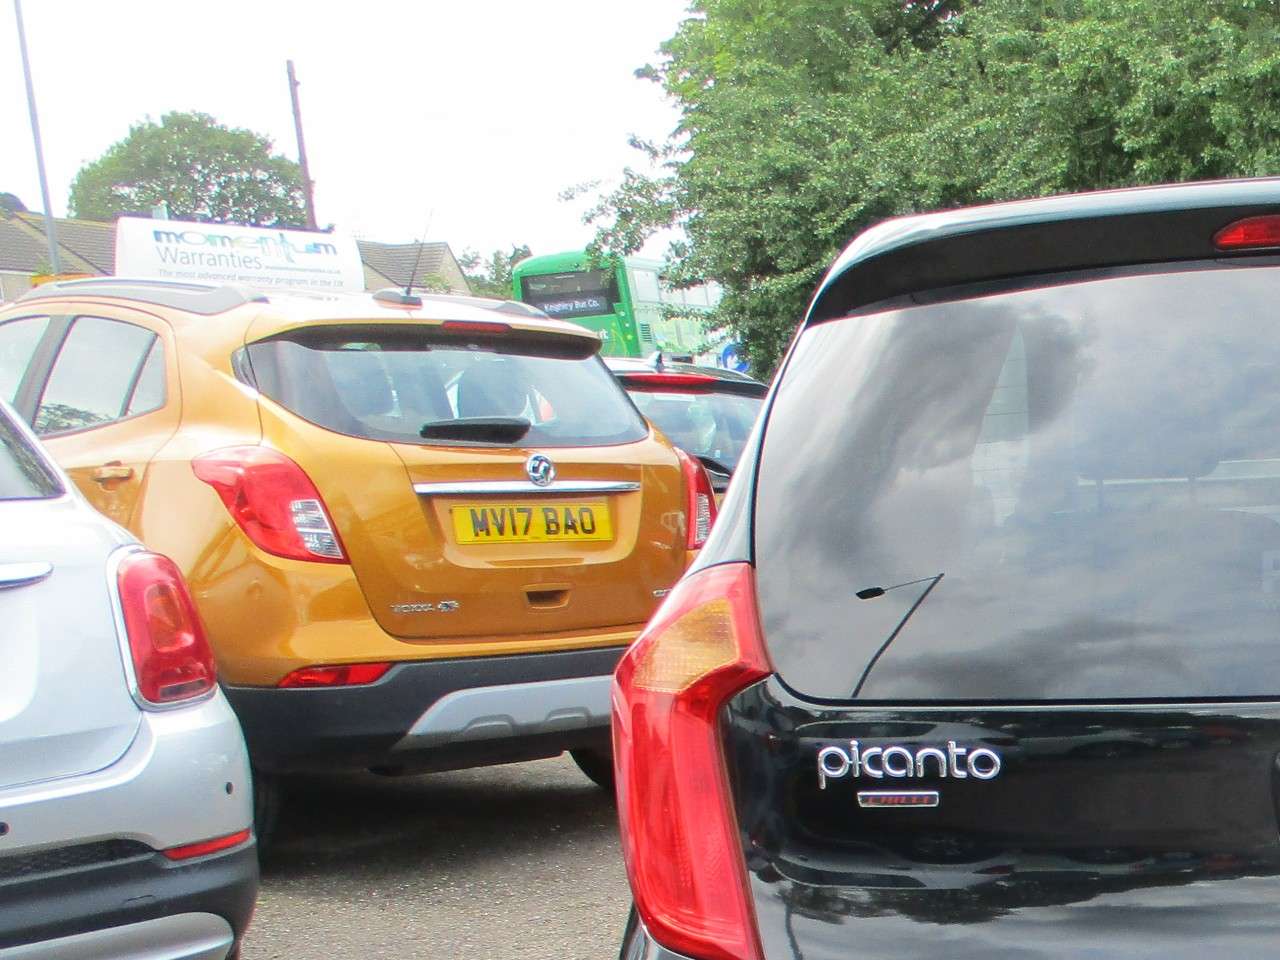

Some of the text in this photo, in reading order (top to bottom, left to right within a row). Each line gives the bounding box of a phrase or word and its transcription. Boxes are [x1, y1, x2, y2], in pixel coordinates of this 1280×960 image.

[156, 246, 263, 271] Warranties
[159, 269, 174, 277] The
[176, 271, 196, 279] most
[197, 271, 237, 281] advanced
[238, 274, 274, 284] warranty
[276, 276, 311, 286] program
[575, 300, 587, 310] Bus
[470, 507, 596, 536] MV17 BAO
[816, 740, 1001, 790] picanto
